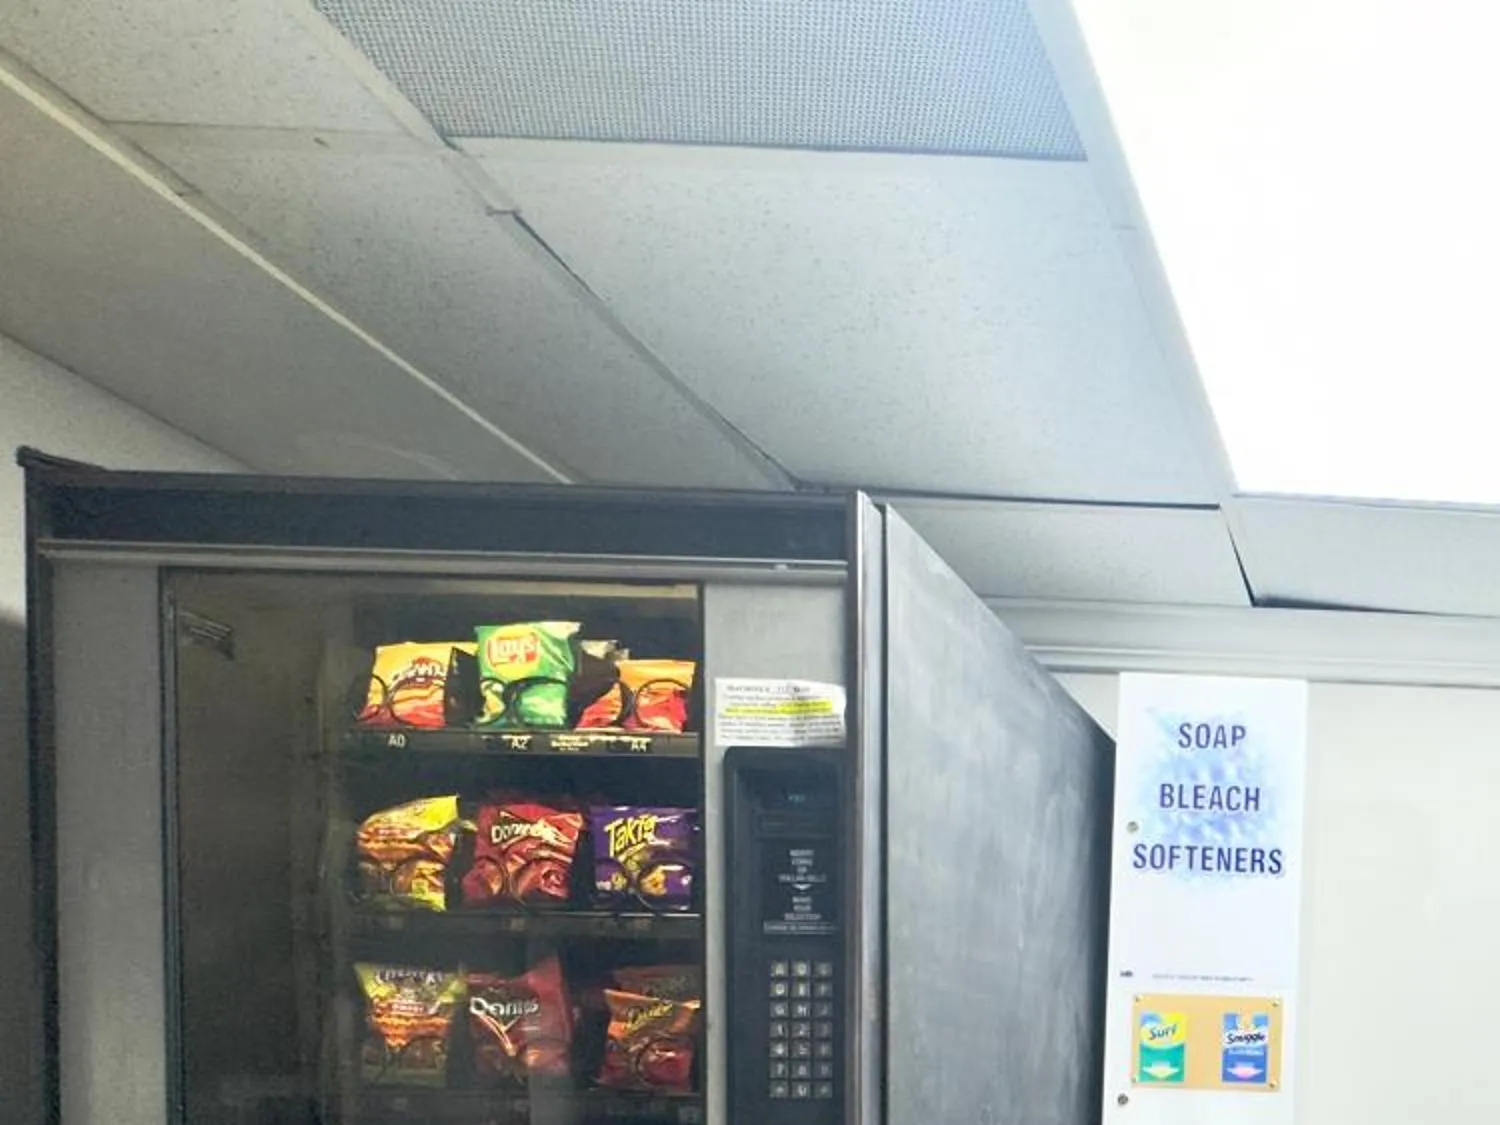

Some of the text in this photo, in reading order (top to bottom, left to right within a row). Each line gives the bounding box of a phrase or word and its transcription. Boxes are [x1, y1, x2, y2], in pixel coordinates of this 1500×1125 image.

[1177, 722, 1247, 749] SOAP
[1158, 783, 1261, 811] BLEACH
[1132, 843, 1283, 875] SOFTENERS
[1148, 1023, 1178, 1040] Surf
